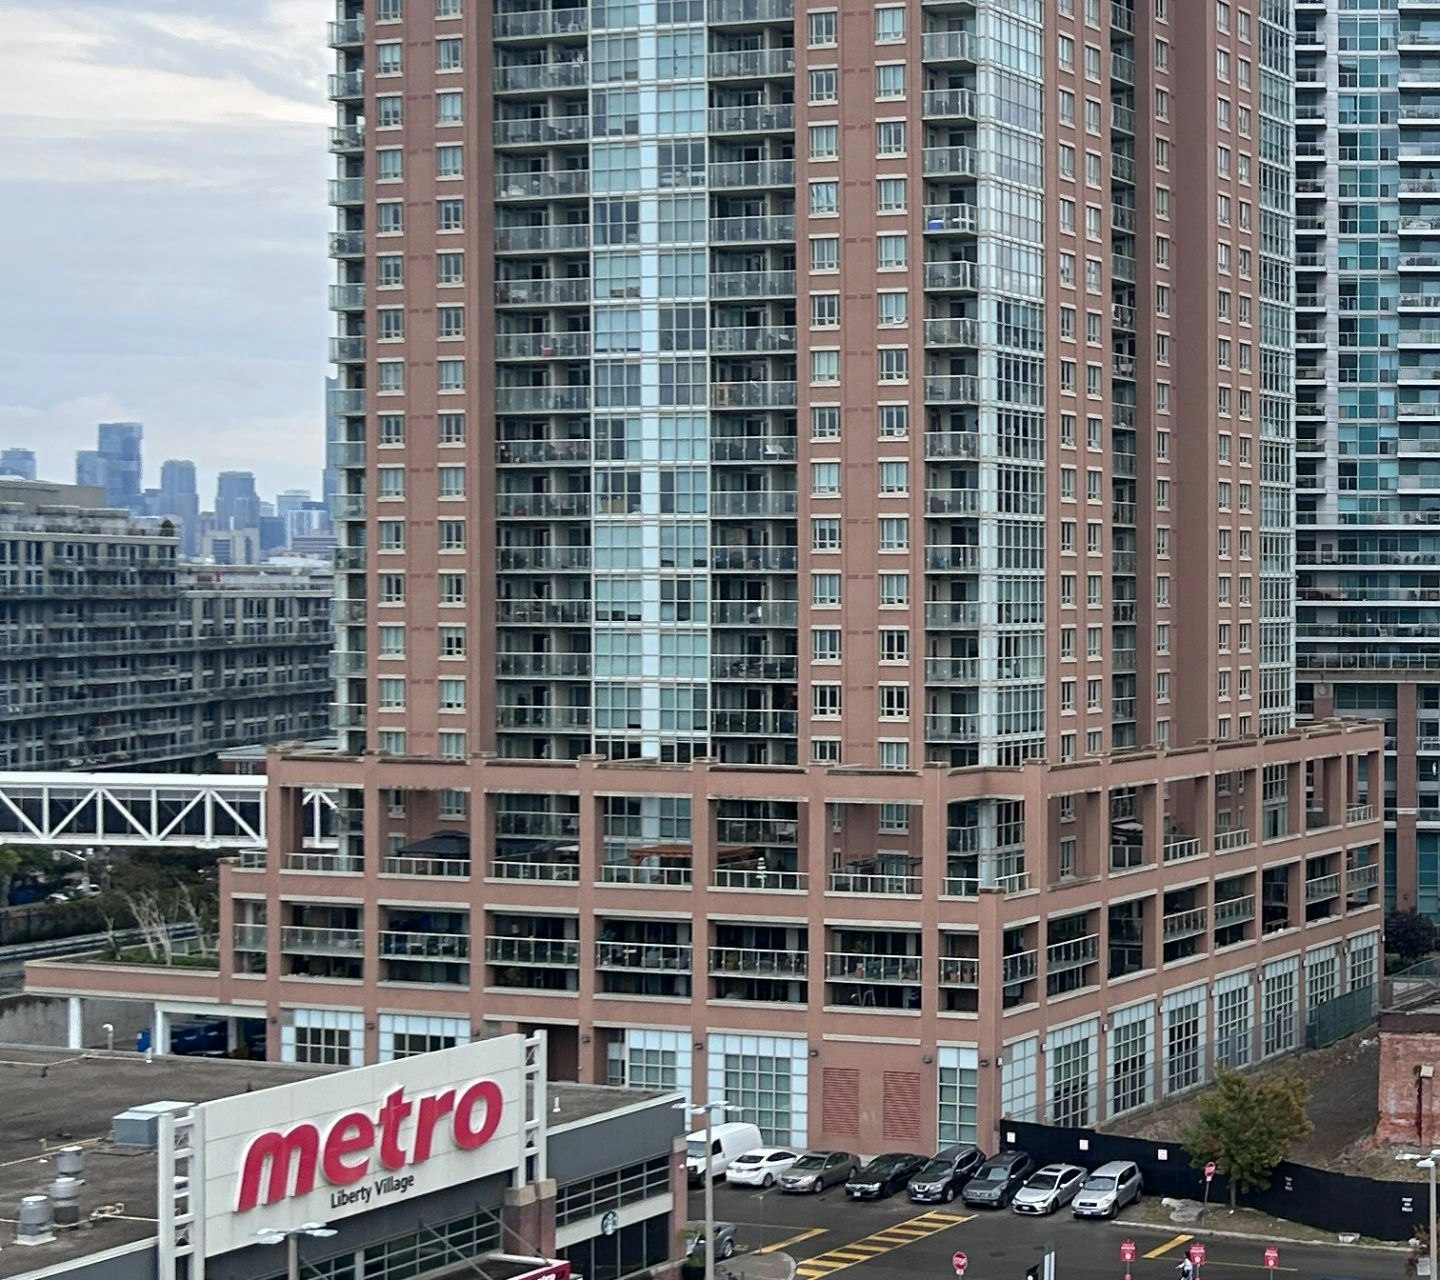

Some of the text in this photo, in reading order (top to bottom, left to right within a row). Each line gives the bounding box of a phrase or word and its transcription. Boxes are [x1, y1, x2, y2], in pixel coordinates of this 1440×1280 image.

[234, 1079, 504, 1213] metro
[331, 1172, 415, 1208] Liberty Village
